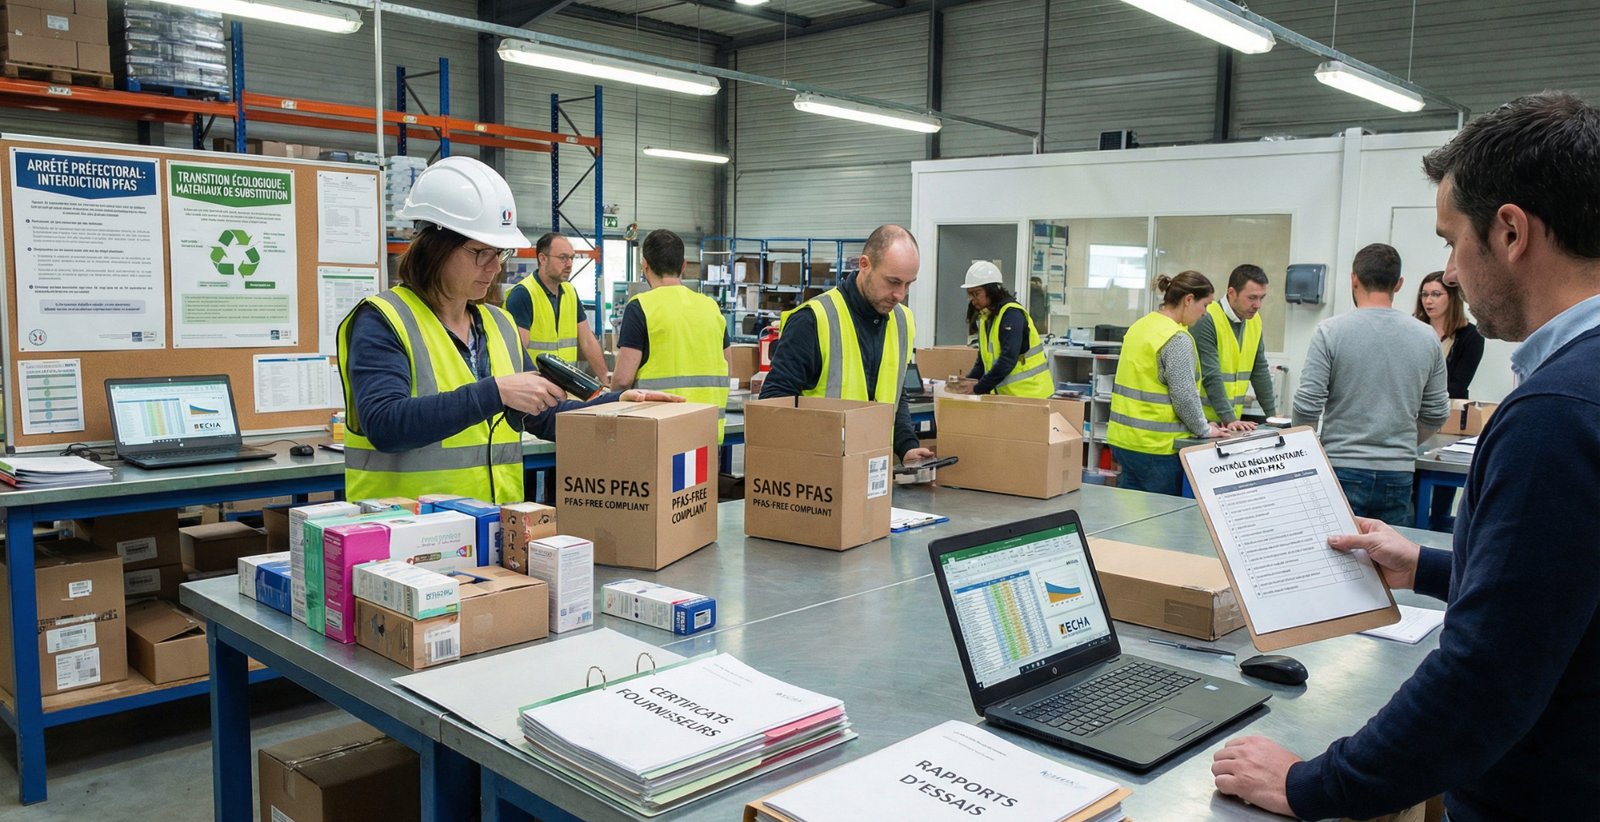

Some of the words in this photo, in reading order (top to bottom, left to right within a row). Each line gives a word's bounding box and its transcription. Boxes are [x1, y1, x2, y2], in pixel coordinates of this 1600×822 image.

[37, 173, 111, 190] INTERDICTION
[112, 179, 138, 191] PFAS
[177, 171, 230, 186] TRANSITION
[223, 187, 234, 197] DE
[1209, 460, 1247, 474] CONTRÔLE
[1235, 469, 1248, 478] LOI
[564, 476, 606, 494] SANS
[610, 480, 650, 498] PFAS
[753, 478, 791, 498] SANS
[796, 483, 833, 503] PFAS
[564, 497, 603, 508] PFAS-FREE
[605, 500, 650, 512] COMPLIANT
[672, 488, 707, 510] PFAS-FREE
[753, 498, 789, 511] PFAS-FREE
[790, 503, 832, 517] COMPLIANT
[672, 502, 708, 524] COMPLIANT
[1065, 616, 1091, 633] ECHA
[616, 688, 721, 738] FOURNISSEURS
[649, 686, 734, 725] CERTIFICATS
[915, 760, 1018, 808] RAPPORTS
[899, 774, 987, 816] D'ESSAIS
